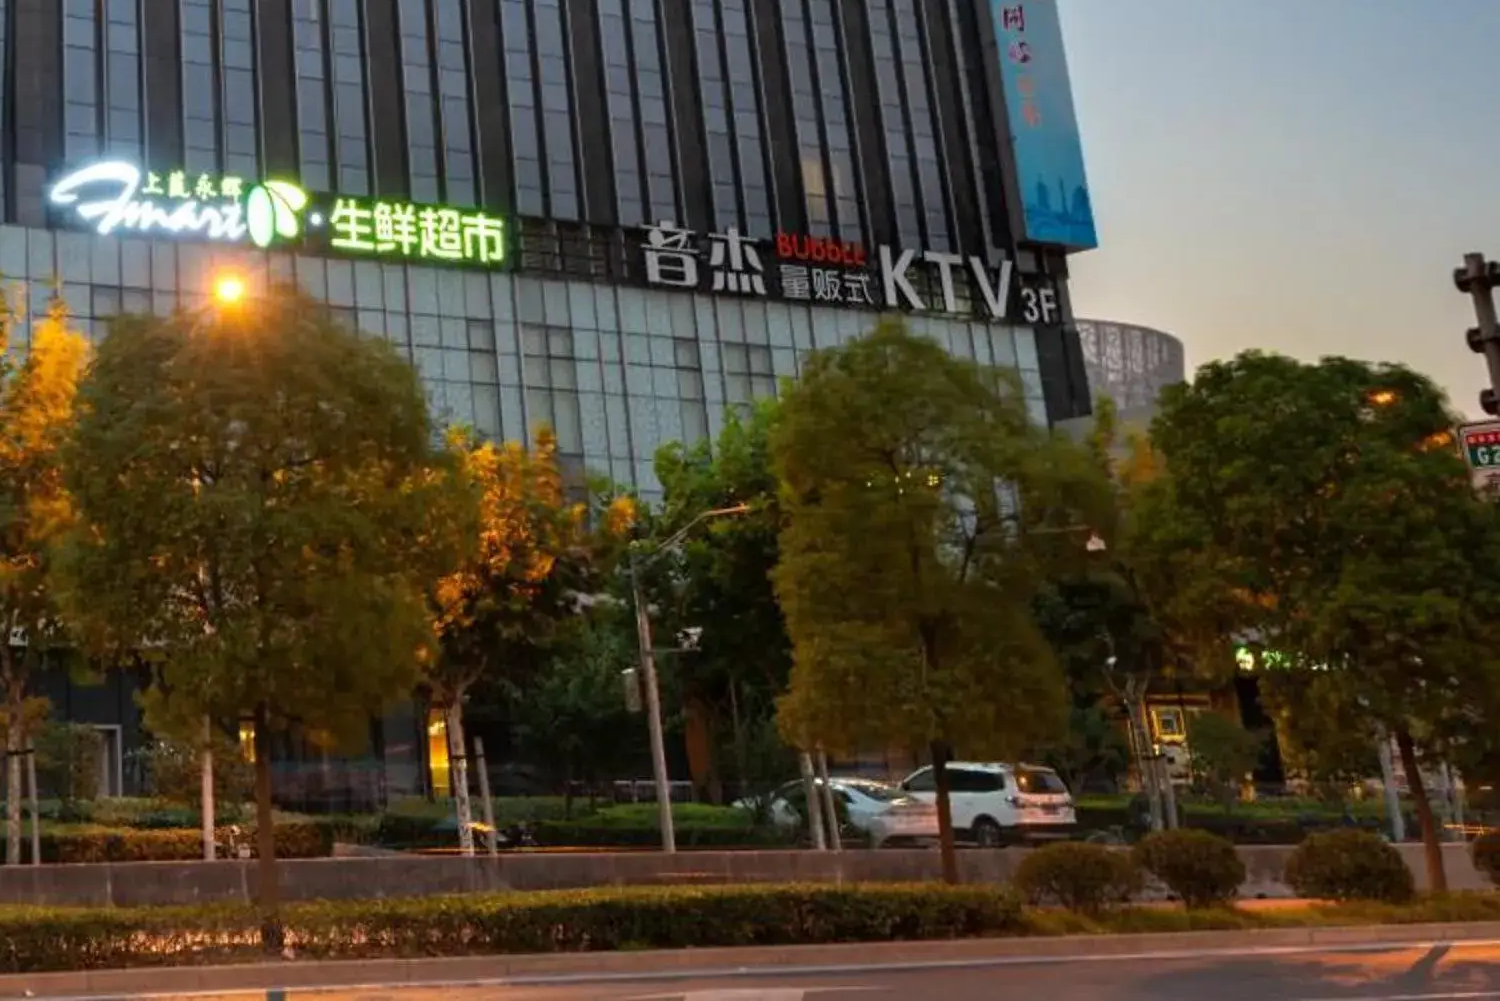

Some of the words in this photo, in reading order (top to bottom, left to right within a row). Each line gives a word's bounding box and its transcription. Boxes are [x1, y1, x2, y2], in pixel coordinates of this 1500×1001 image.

[330, 198, 505, 263] 生鲜超市
[779, 263, 874, 305] 量贩式
[879, 243, 1013, 319] KTV
[1020, 287, 1057, 324] 3F
